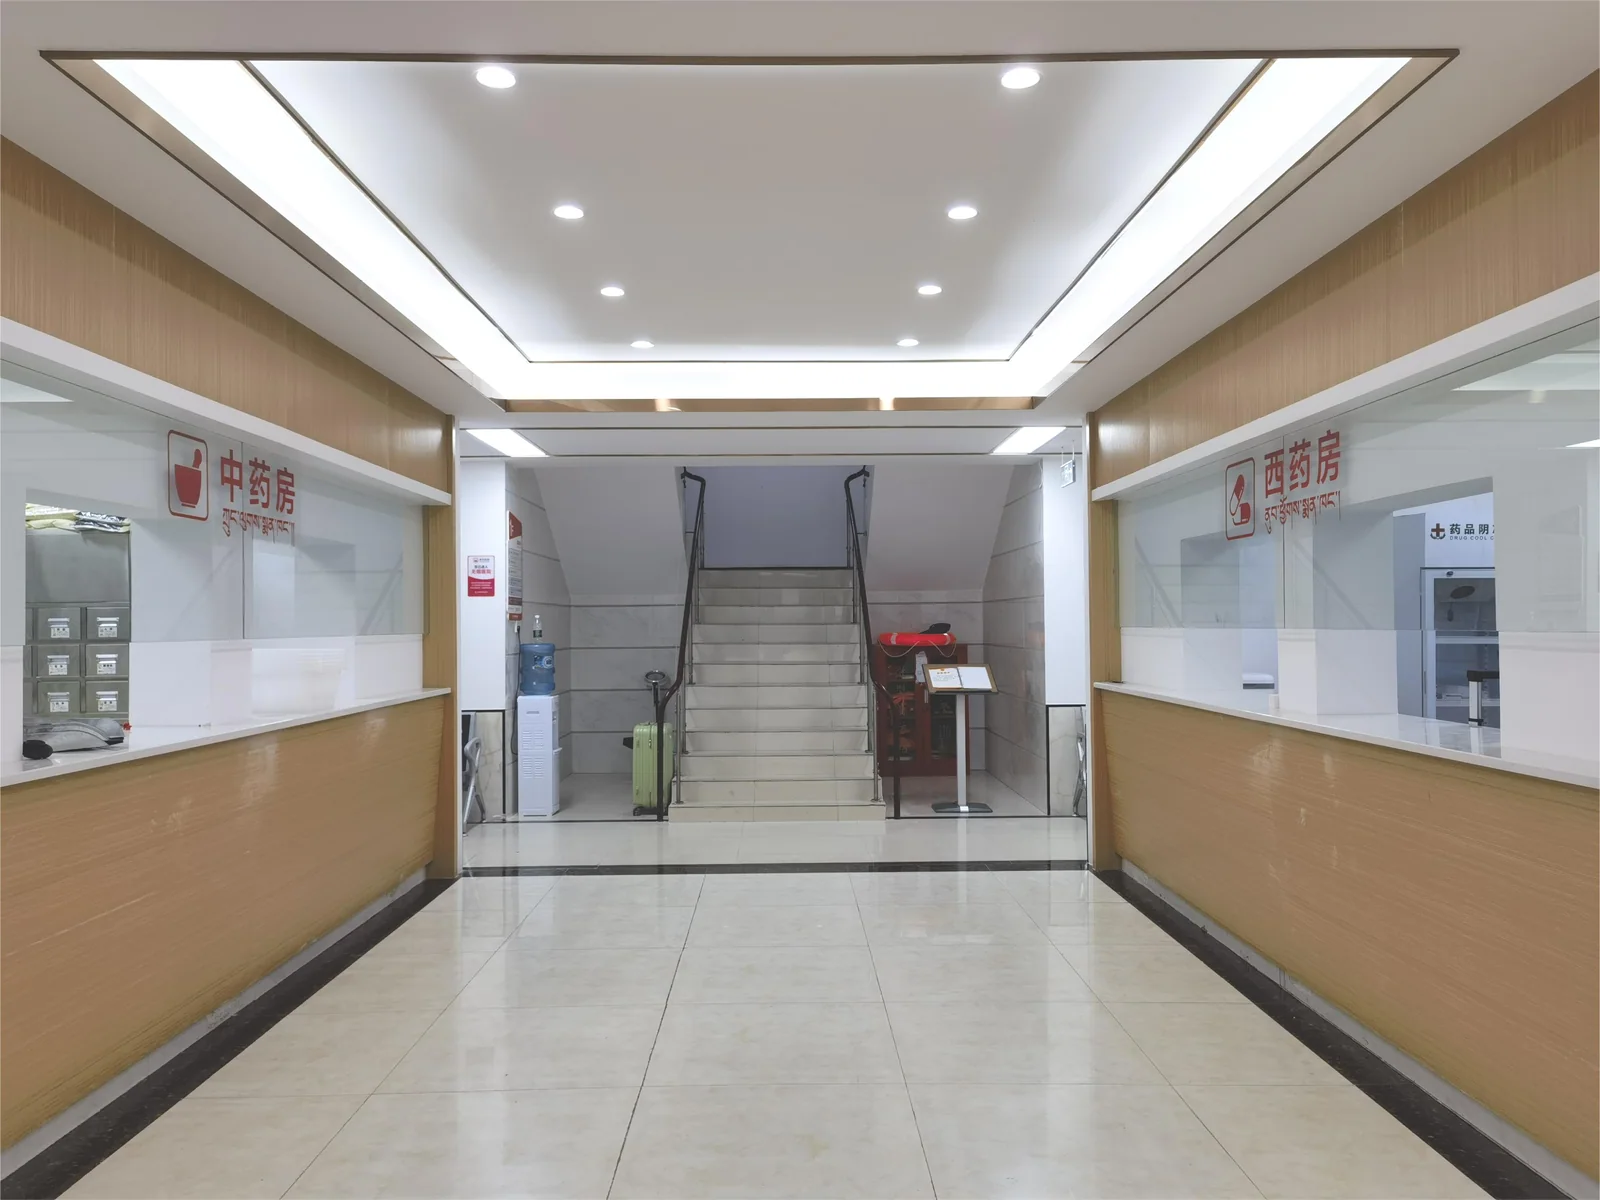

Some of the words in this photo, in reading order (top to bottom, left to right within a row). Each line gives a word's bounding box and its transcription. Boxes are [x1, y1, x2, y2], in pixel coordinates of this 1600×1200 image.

[220, 449, 296, 514] 中药房
[1264, 430, 1341, 498] 西药房
